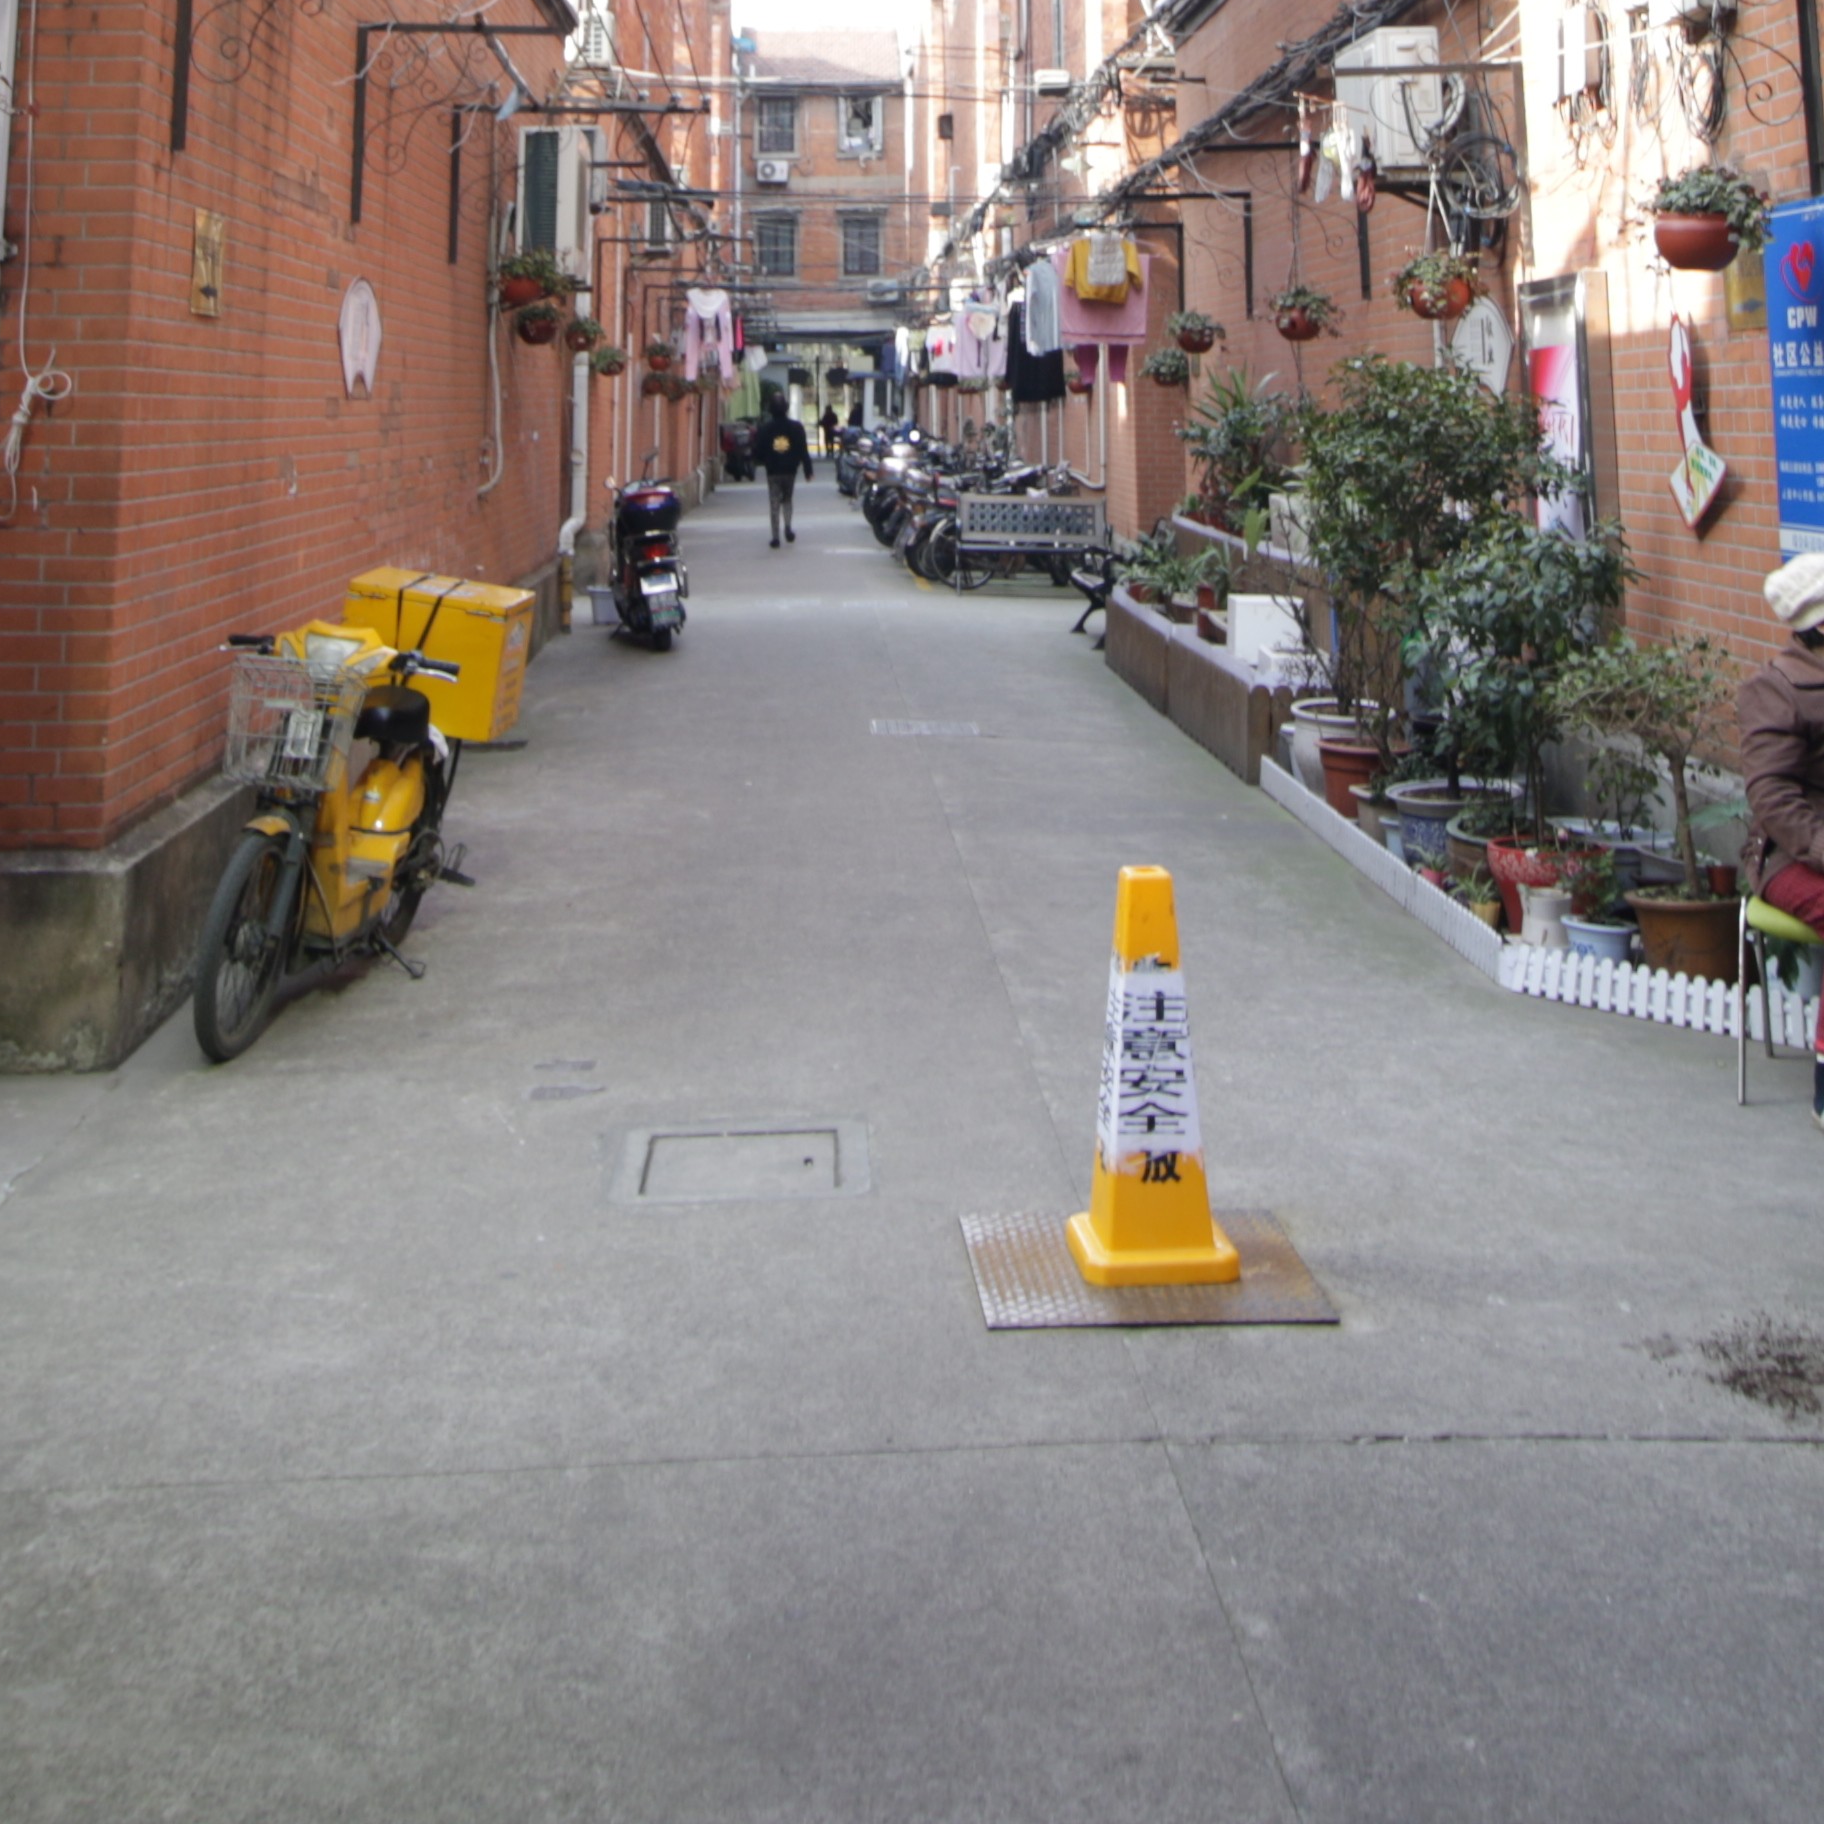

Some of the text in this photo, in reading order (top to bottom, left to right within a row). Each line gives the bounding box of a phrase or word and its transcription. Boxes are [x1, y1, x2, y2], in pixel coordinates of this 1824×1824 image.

[1787, 305, 1818, 329] CPW
[1119, 991, 1189, 1135] 注意安全
